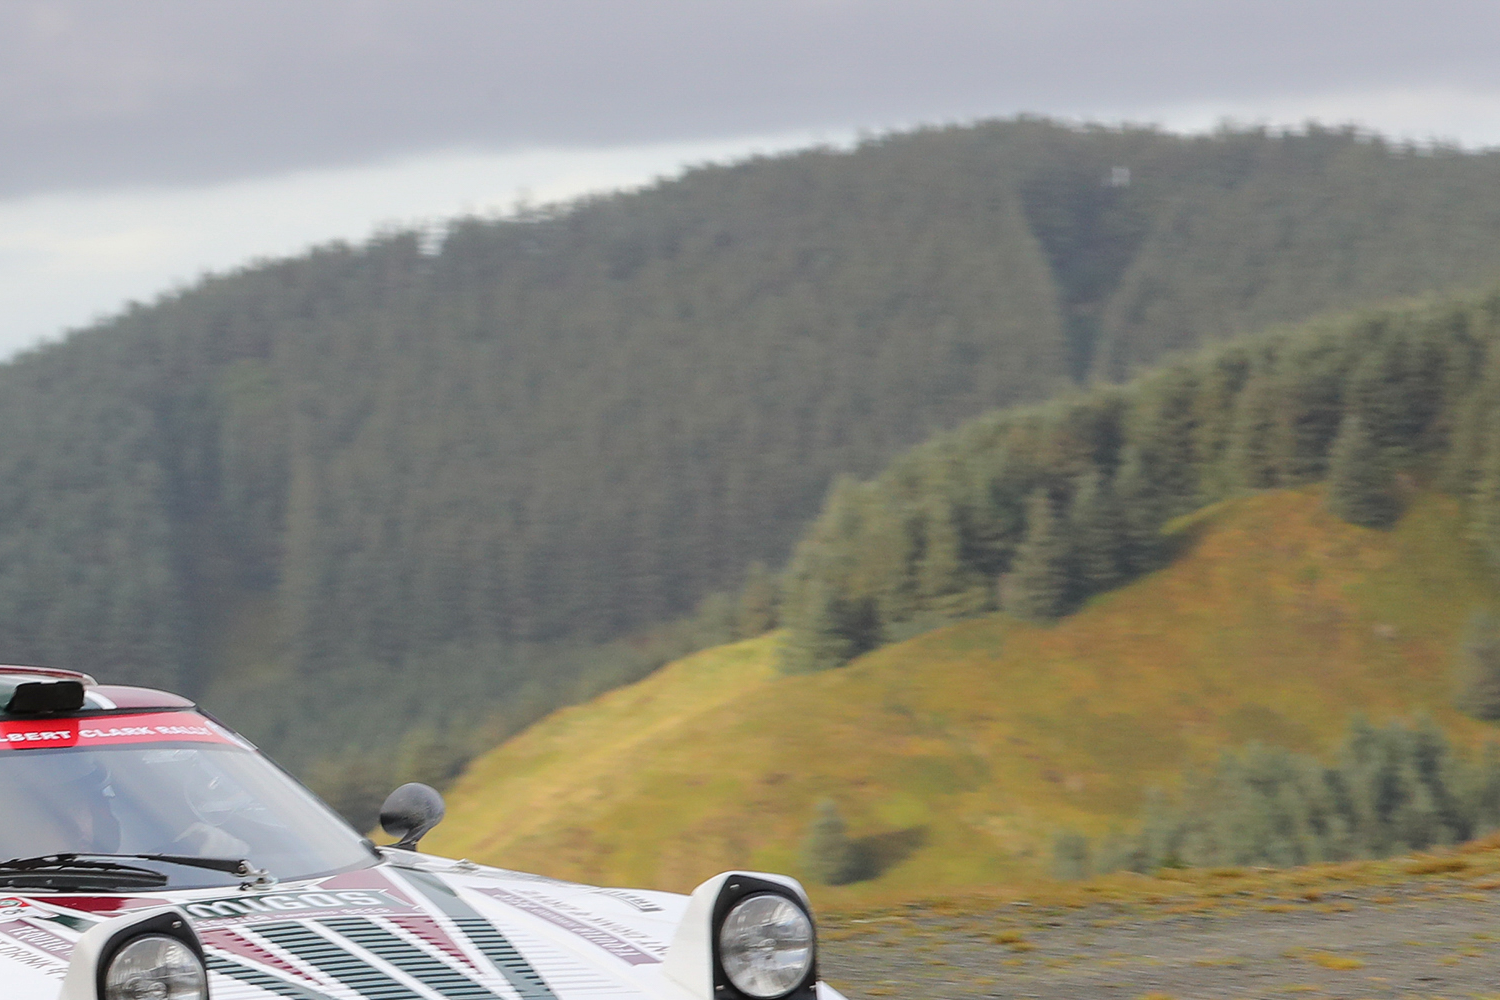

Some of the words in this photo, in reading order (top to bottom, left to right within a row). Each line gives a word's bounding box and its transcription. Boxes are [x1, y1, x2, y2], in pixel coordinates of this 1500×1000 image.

[78, 726, 156, 738] CLARK
[154, 725, 213, 736] RALLY
[186, 892, 383, 918] MIGOS
